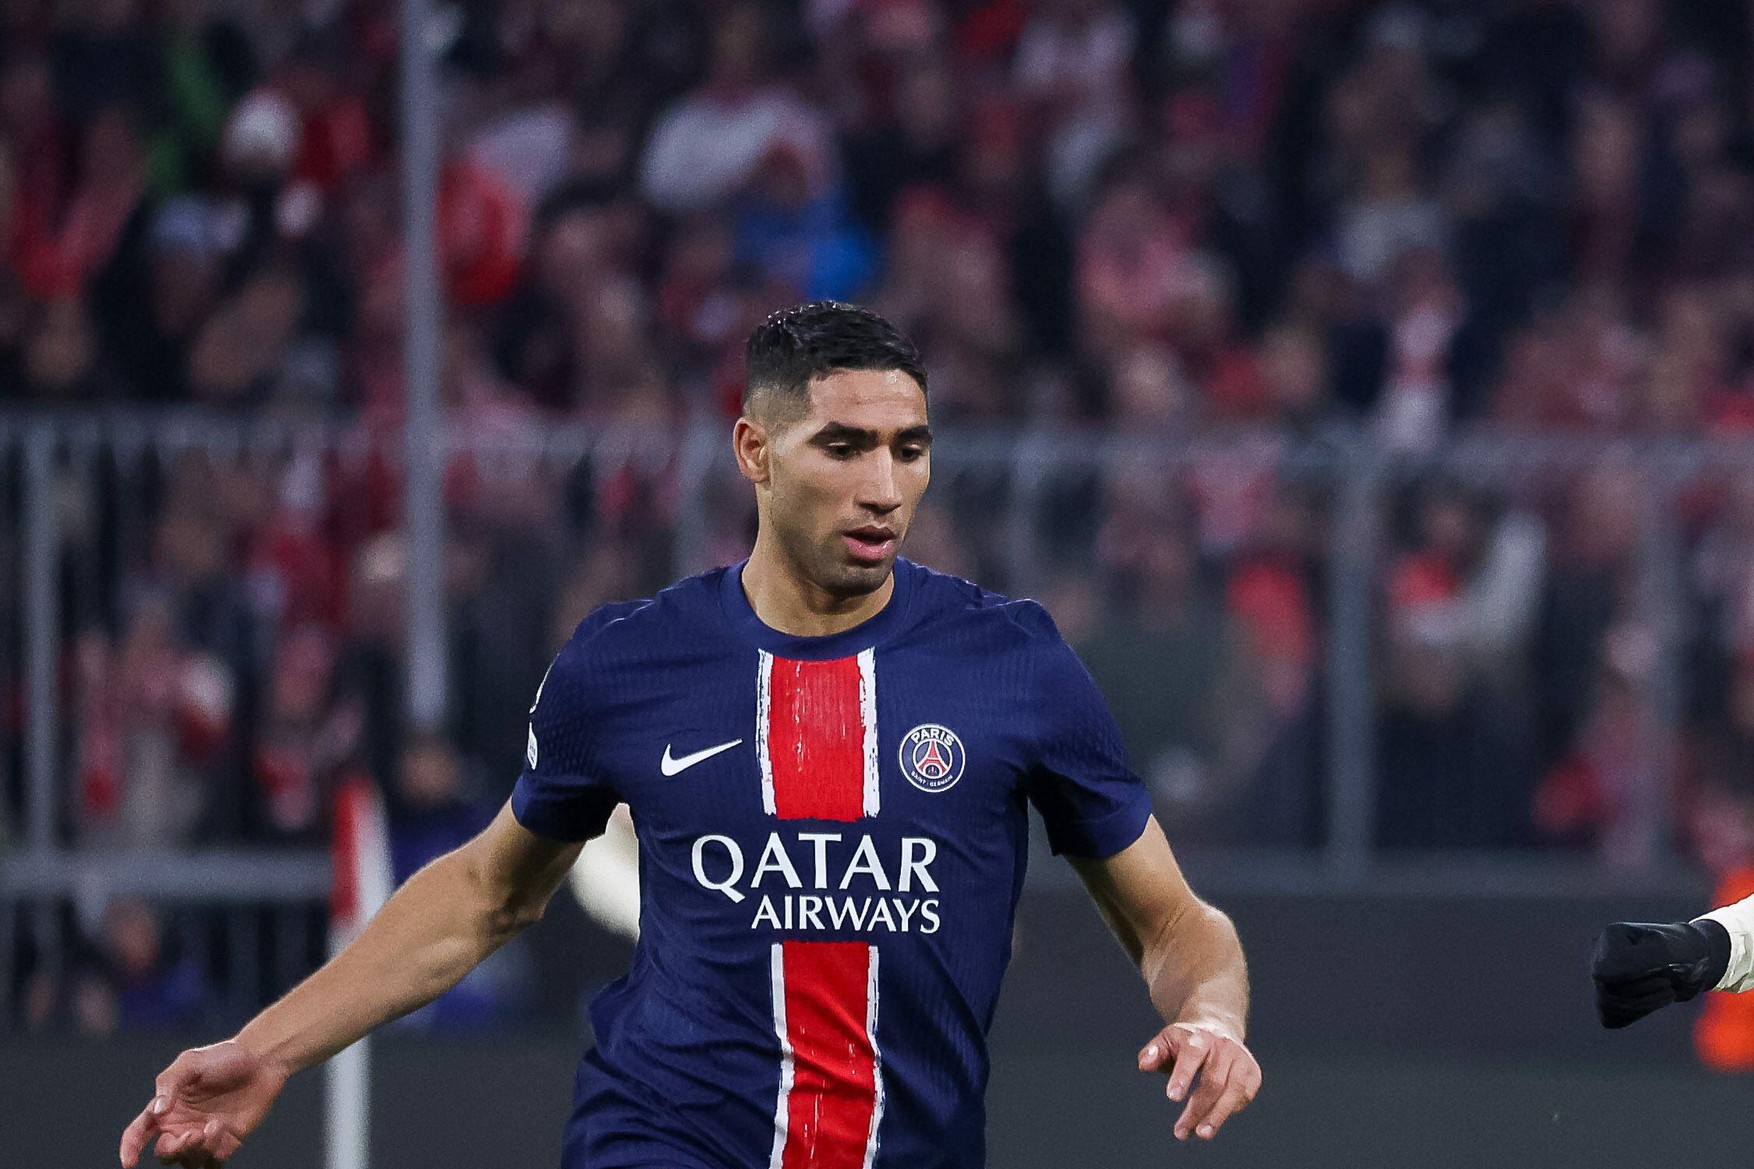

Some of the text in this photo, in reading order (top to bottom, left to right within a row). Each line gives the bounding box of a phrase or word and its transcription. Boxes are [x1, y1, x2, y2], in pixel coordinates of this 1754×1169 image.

[910, 728, 955, 746] PARIS
[691, 832, 940, 903] QATAR
[751, 894, 941, 934] AIRWAYS
